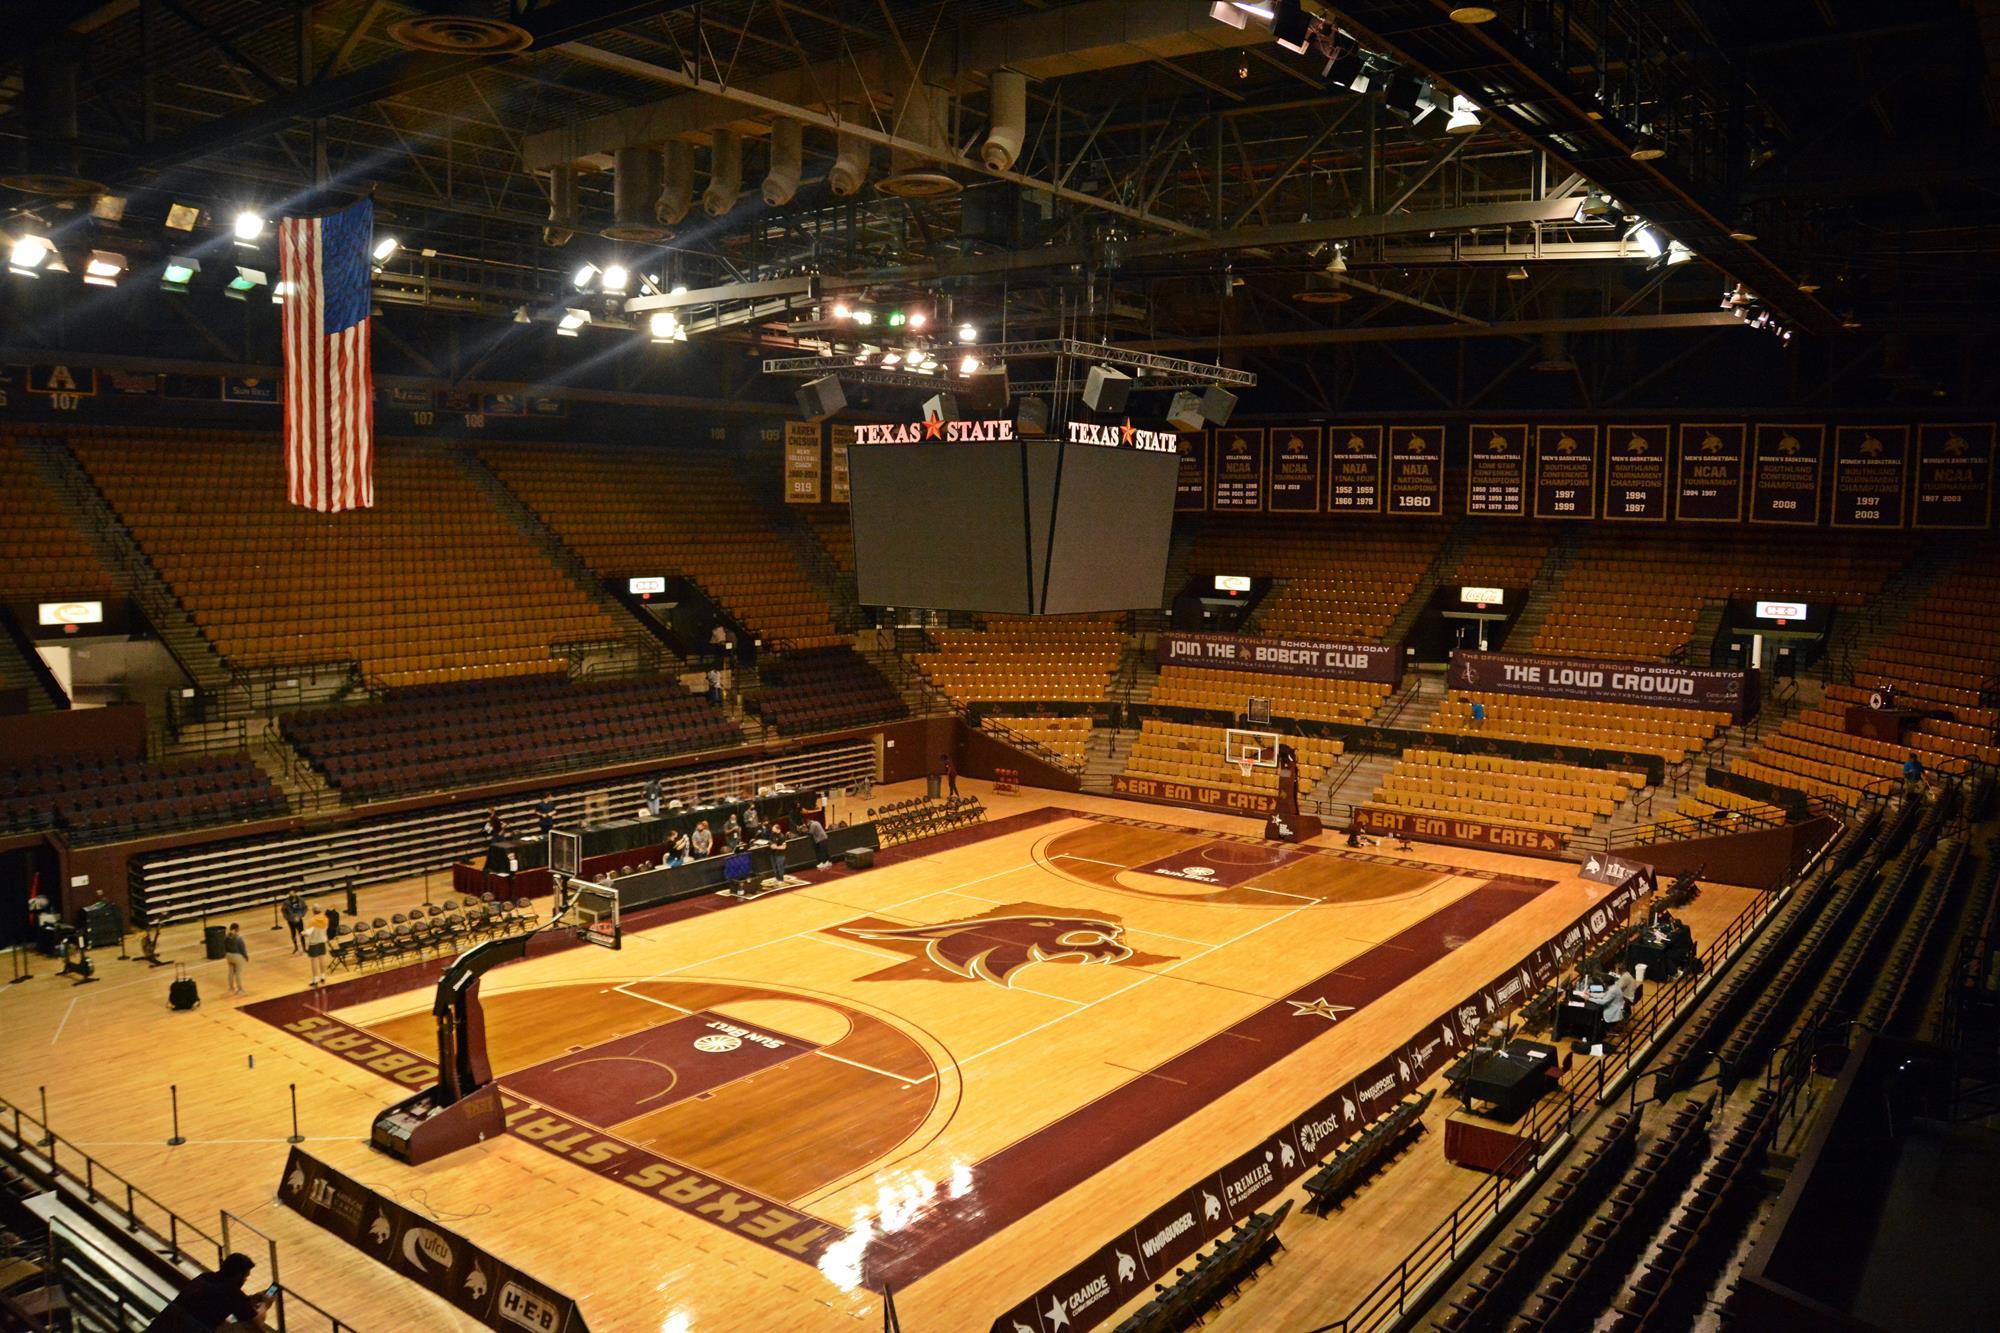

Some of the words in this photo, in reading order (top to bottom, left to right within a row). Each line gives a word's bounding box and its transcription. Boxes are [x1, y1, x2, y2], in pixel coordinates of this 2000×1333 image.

[854, 422, 920, 444] TEXAS
[947, 420, 1012, 442] STATE
[1068, 422, 1119, 447] TEXAS
[1136, 430, 1177, 452] STATE
[1226, 463, 1250, 472] NCAA
[1282, 464, 1308, 473] NCAA
[1342, 464, 1368, 474] NAIA
[1402, 464, 1429, 475] NAIA
[1694, 466, 1728, 478] NCAA
[1934, 468, 1975, 480] NCAA
[794, 482, 812, 492] 919
[1610, 480, 1662, 488] CHAMPIONS
[1555, 490, 1576, 498] 1997
[1625, 492, 1646, 500] 1994
[1400, 496, 1431, 506] 1960
[1554, 502, 1575, 511] 1999
[1772, 500, 1797, 510] 2008
[1856, 496, 1880, 506] 1997
[1624, 504, 1646, 512] 1997
[1855, 510, 1880, 520] 2003
[1280, 641, 1354, 652] SCHOLARSHIPS
[1170, 640, 1201, 658] JOIN
[1206, 643, 1236, 658] THE
[1256, 647, 1320, 666] BOBCAT
[1326, 652, 1368, 668] CLUB
[1481, 654, 1519, 662] OFFICIAL
[1525, 658, 1564, 666] STUDENT
[1504, 664, 1540, 682] THE
[1548, 668, 1604, 688] LOUD
[1612, 673, 1694, 695] CROWD
[1128, 779, 1158, 796] EAT
[1162, 784, 1192, 800] 'EM
[1198, 788, 1221, 804] UP
[1227, 793, 1268, 811] CATS
[1372, 812, 1406, 830] EAT
[1412, 818, 1446, 836] 'EM
[1454, 824, 1482, 840] UP
[1490, 828, 1538, 848] CATS
[283, 1016, 440, 1091] OBCATS
[501, 1096, 629, 1165] STAT
[1312, 1112, 1339, 1142] Frost
[1226, 1162, 1271, 1200] PREMIER
[1260, 1174, 1274, 1186] CARE
[624, 1162, 832, 1256] TEXAS
[1142, 1212, 1196, 1258] WHATABURGER
[424, 1238, 448, 1258] ufcu
[1069, 1274, 1108, 1310] GRANDE
